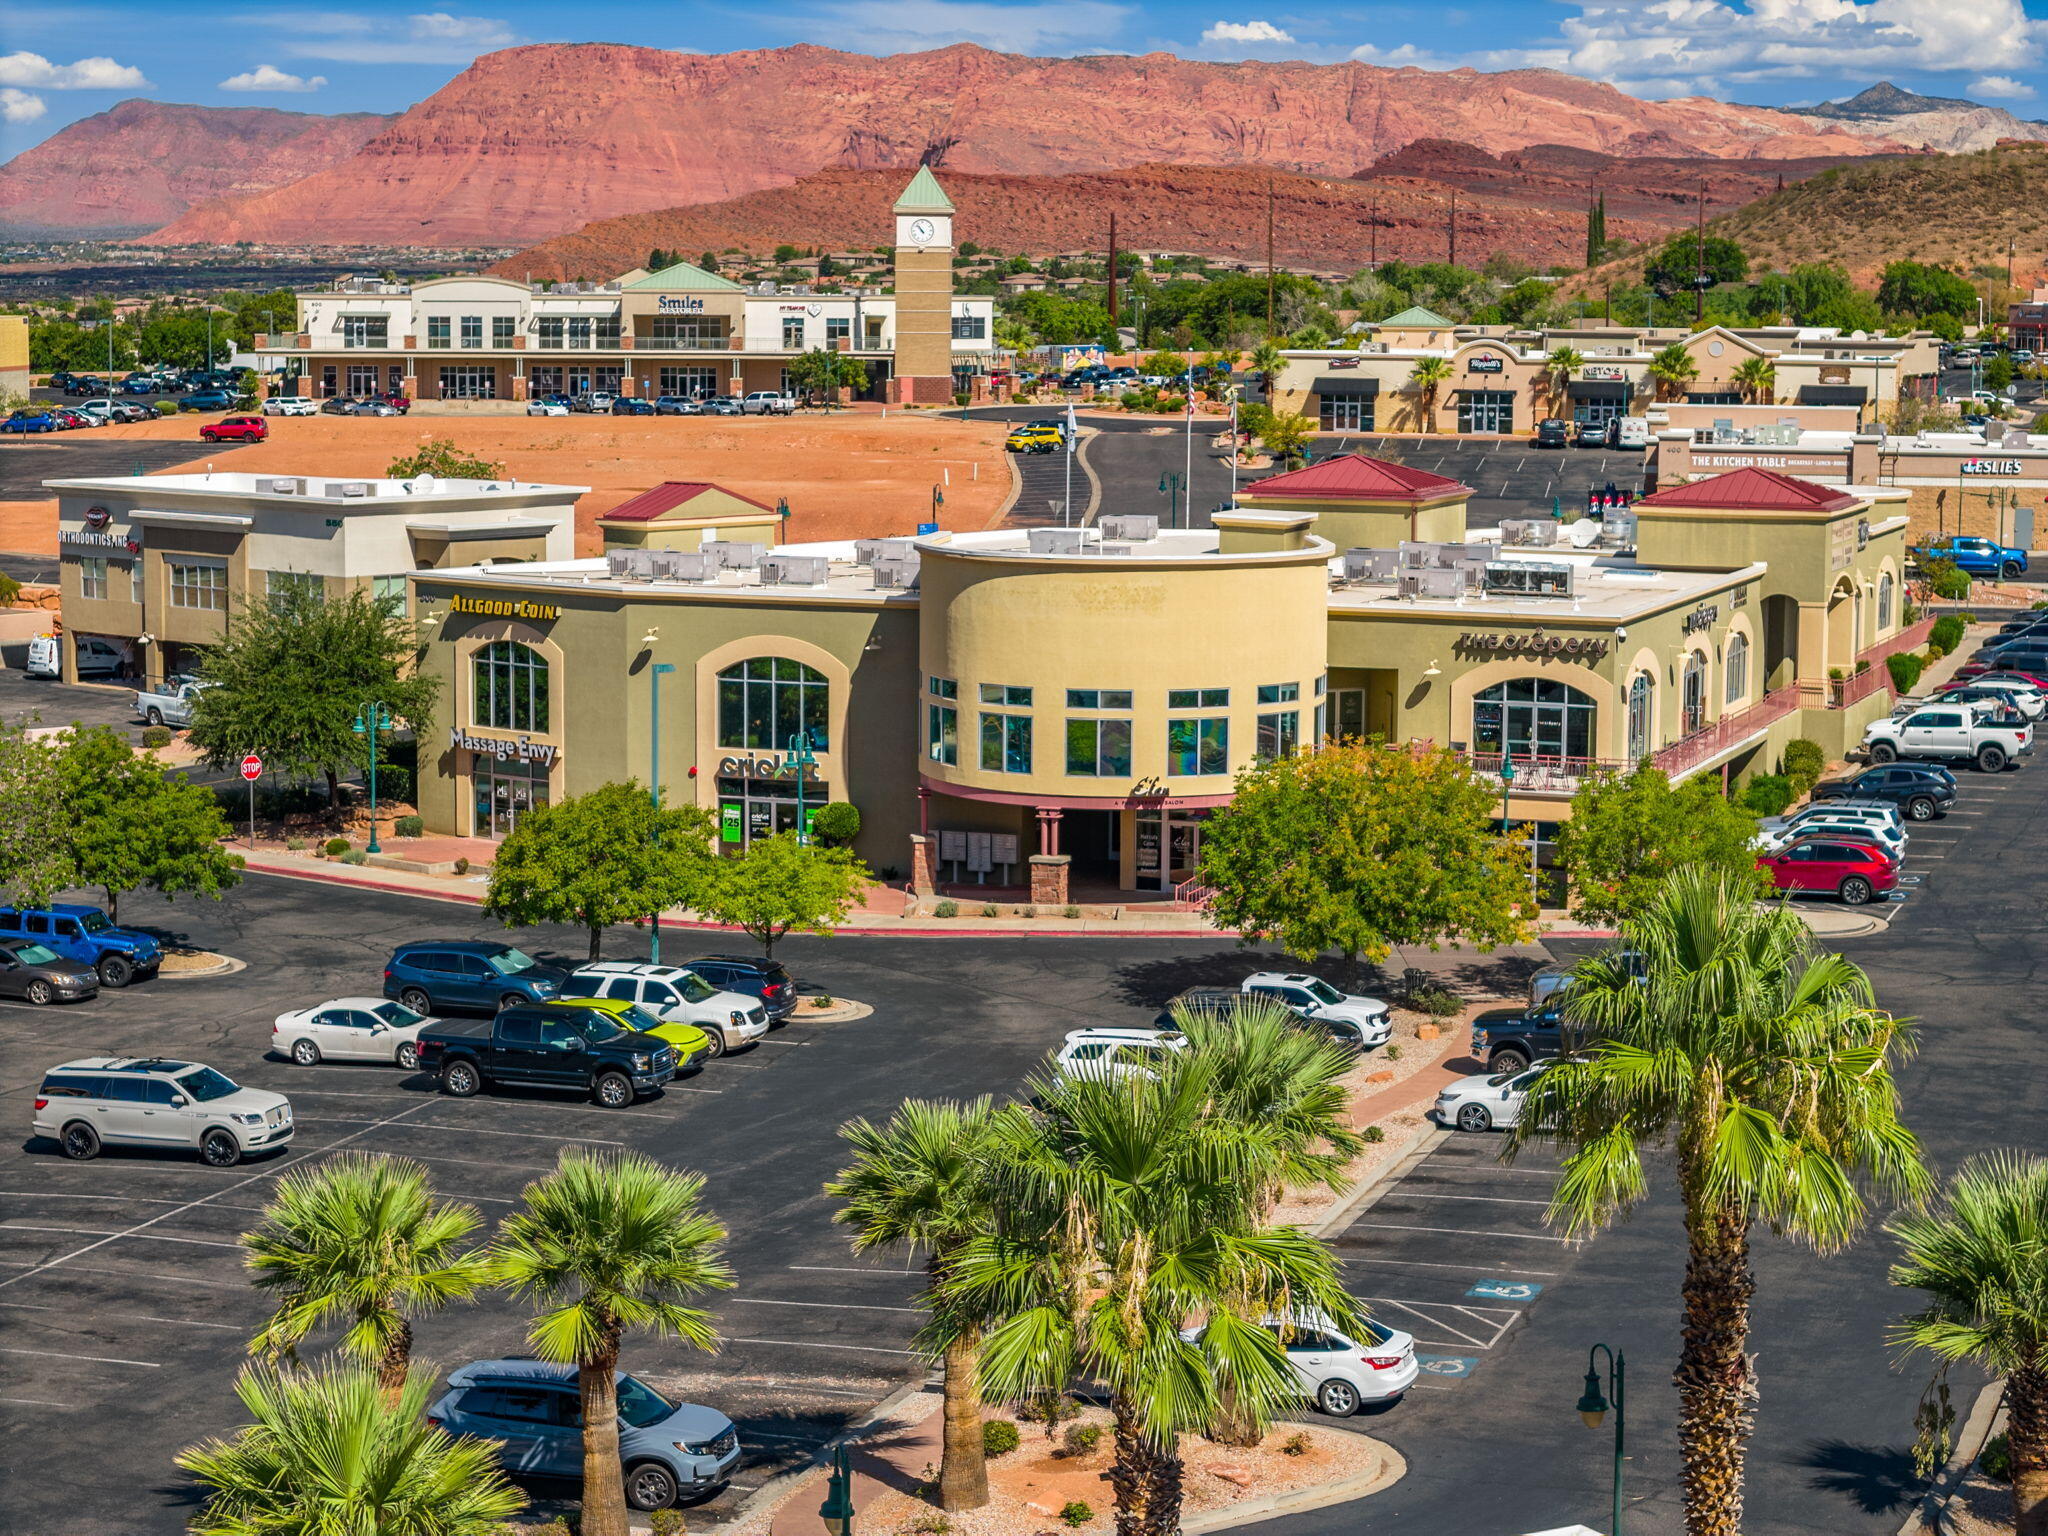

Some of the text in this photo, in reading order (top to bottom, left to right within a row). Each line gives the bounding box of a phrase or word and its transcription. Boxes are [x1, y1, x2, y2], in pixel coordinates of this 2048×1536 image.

[658, 295, 704, 308] Smiles
[658, 307, 704, 315] RESTORED
[1691, 456, 1711, 467] THE
[1712, 457, 1754, 467] KITCHEN
[1756, 457, 1787, 467] TABLE
[1967, 459, 2022, 474] LESLIE'S
[449, 594, 513, 616] ALLGOOD
[1460, 626, 1609, 657] THE crêpery
[450, 727, 557, 767] Massage Envy
[243, 762, 260, 773] STOP
[724, 817, 740, 828] $25
